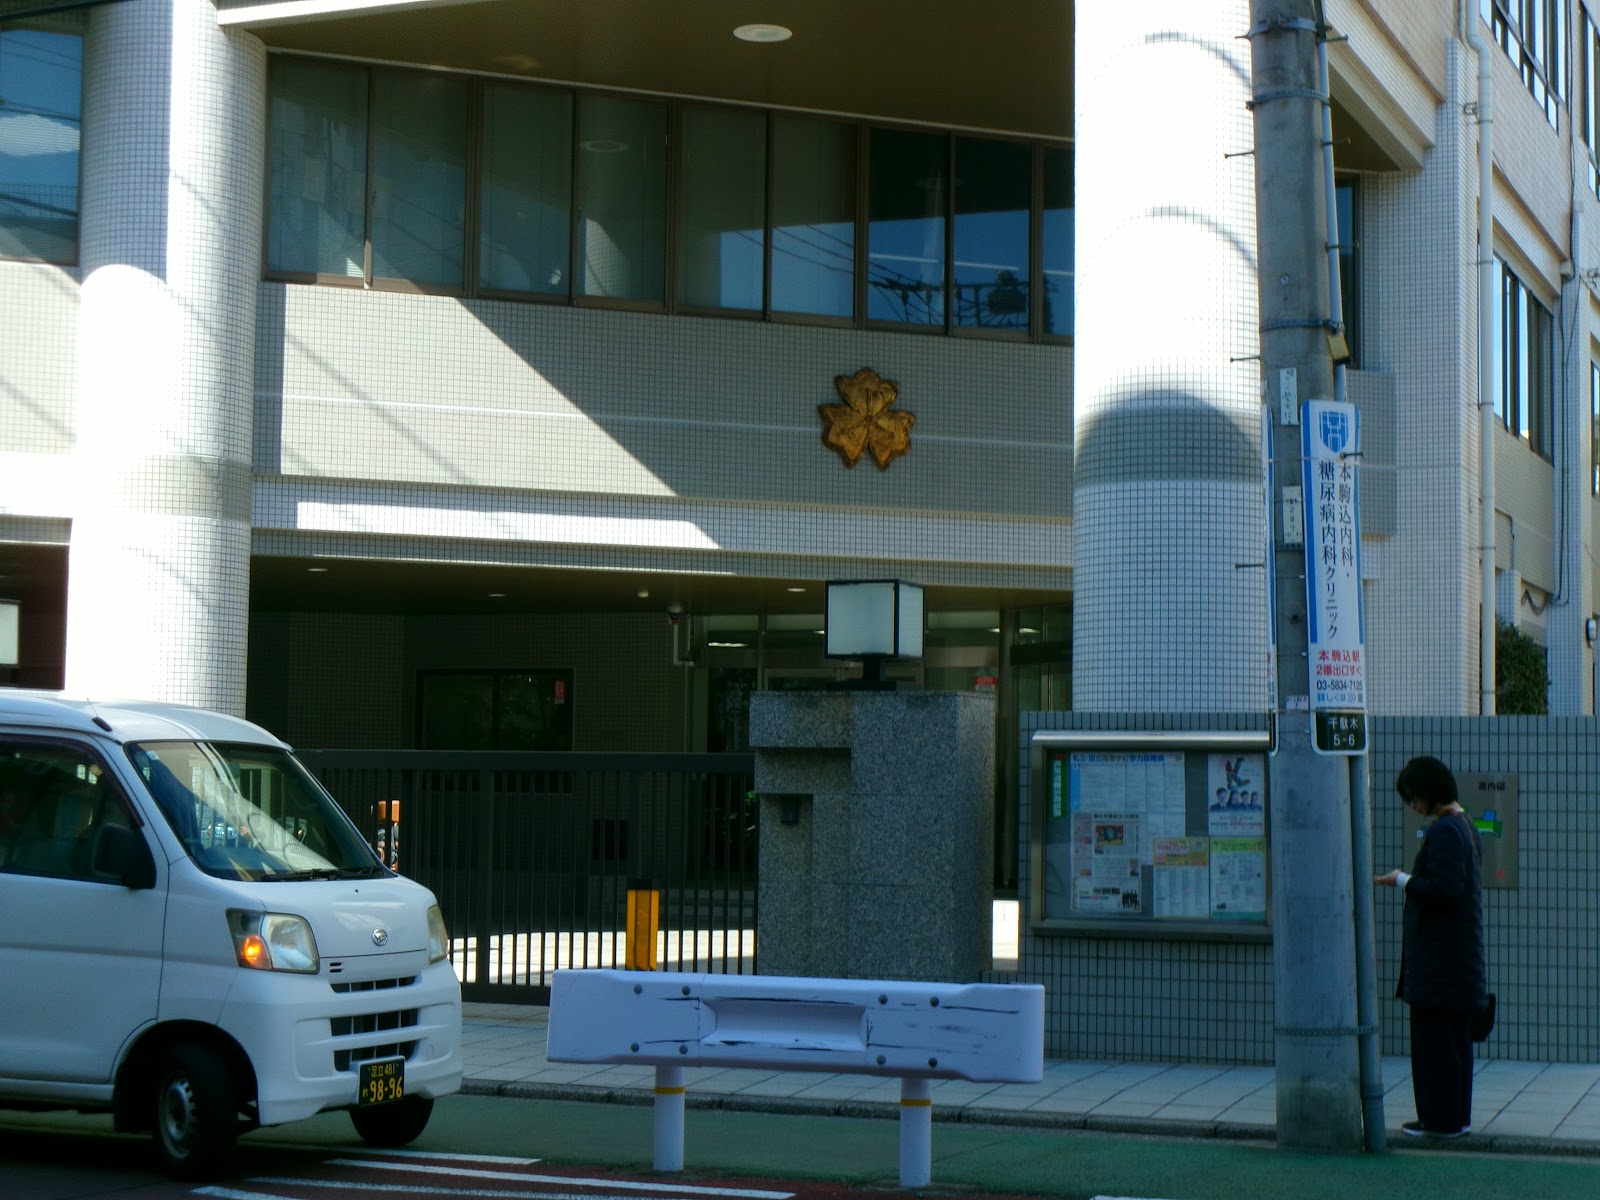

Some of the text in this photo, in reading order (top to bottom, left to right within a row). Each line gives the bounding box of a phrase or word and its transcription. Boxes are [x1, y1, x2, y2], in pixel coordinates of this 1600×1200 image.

[1319, 460, 1338, 640] 糖尿病内科クリニック
[1318, 649, 1361, 663] 本駒込駅
[1328, 716, 1360, 731] 千駄木
[1333, 733, 1355, 746] 5-6
